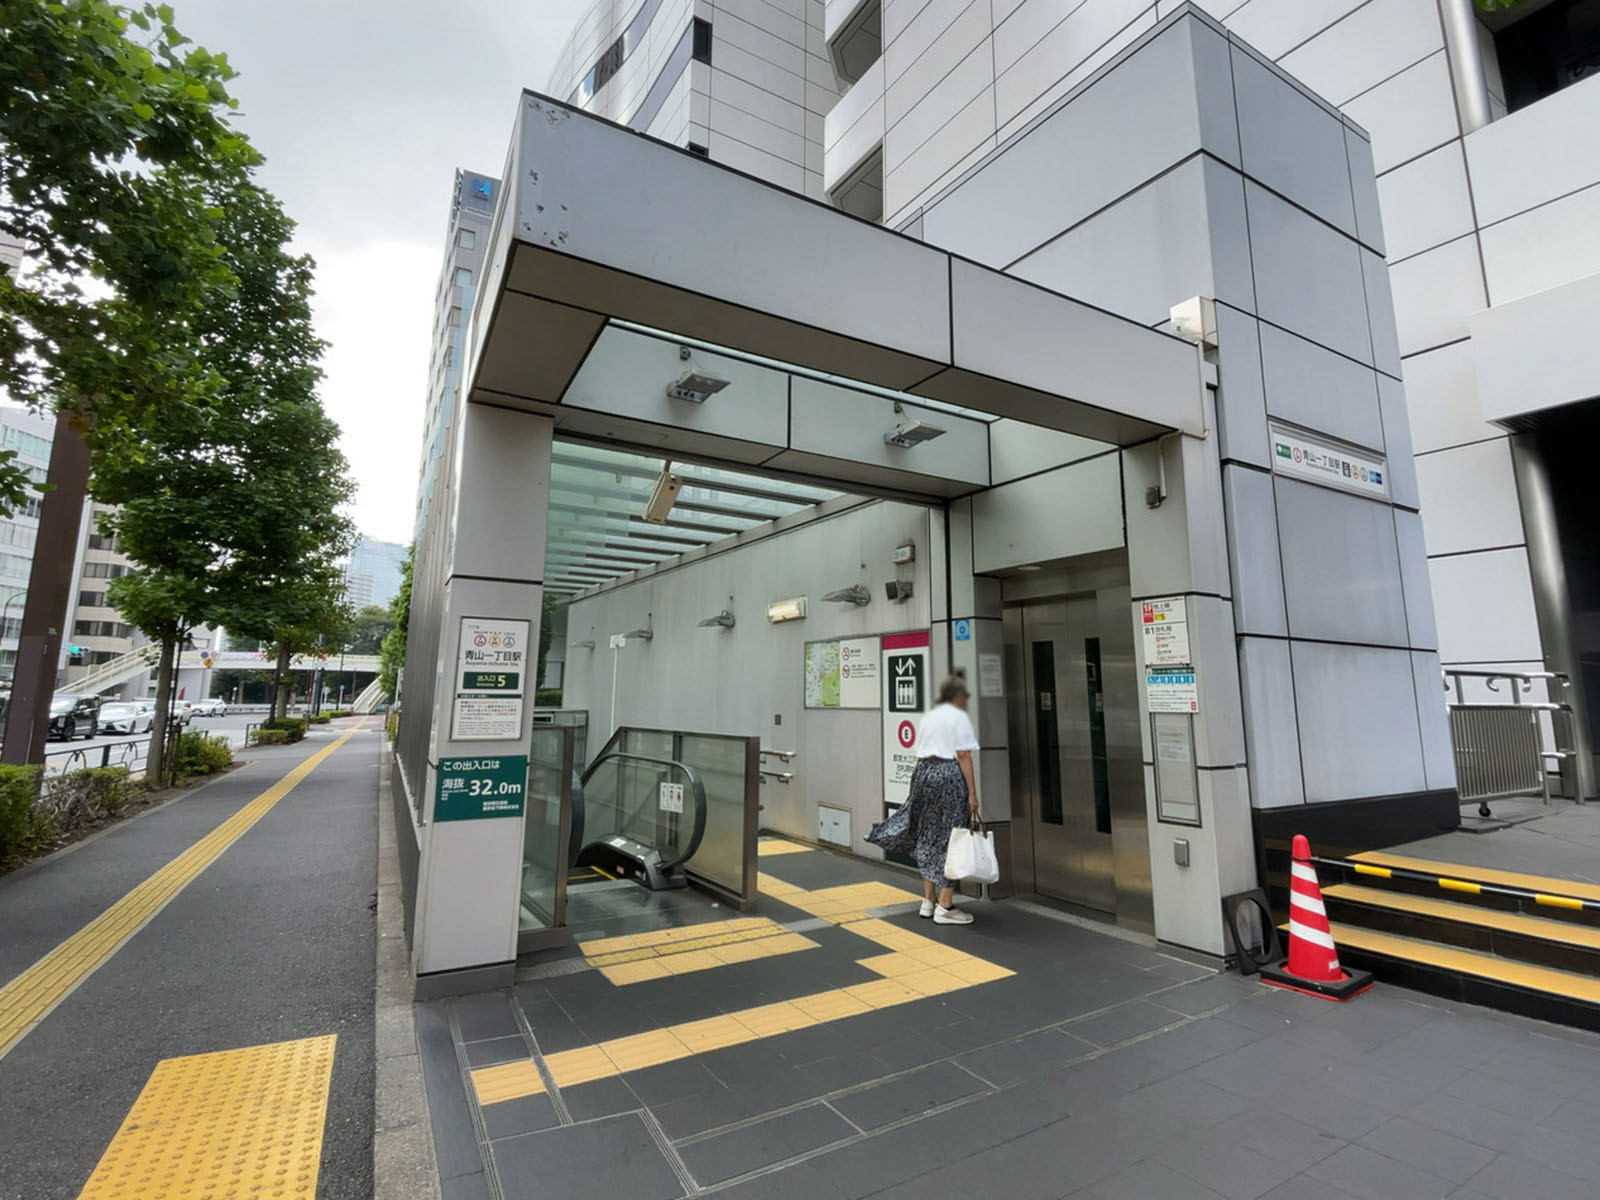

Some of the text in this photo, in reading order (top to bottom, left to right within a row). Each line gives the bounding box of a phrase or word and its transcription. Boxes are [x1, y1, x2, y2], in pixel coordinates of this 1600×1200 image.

[1145, 627, 1154, 635] B1
[465, 650, 521, 661] 青山一丁目駅
[497, 675, 506, 687] 5
[904, 729, 909, 740] E
[443, 760, 500, 771] この出入口は
[442, 778, 521, 796] 海抜 32.0m
